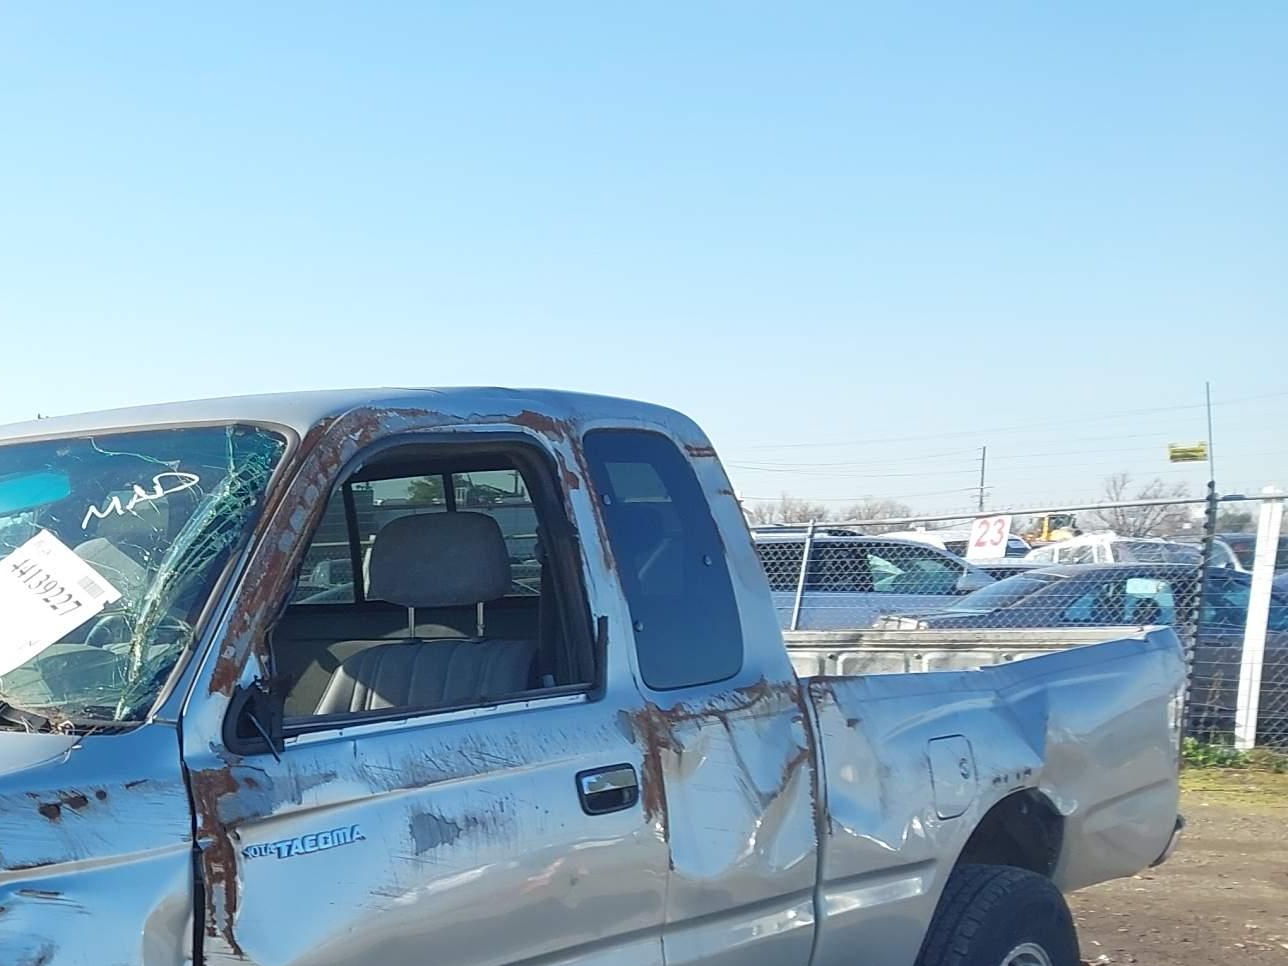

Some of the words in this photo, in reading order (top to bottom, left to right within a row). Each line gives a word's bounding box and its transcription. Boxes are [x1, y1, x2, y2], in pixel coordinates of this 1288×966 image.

[974, 518, 1006, 547] 23
[10, 557, 83, 617] 44139227
[274, 823, 366, 859] TACOMA
